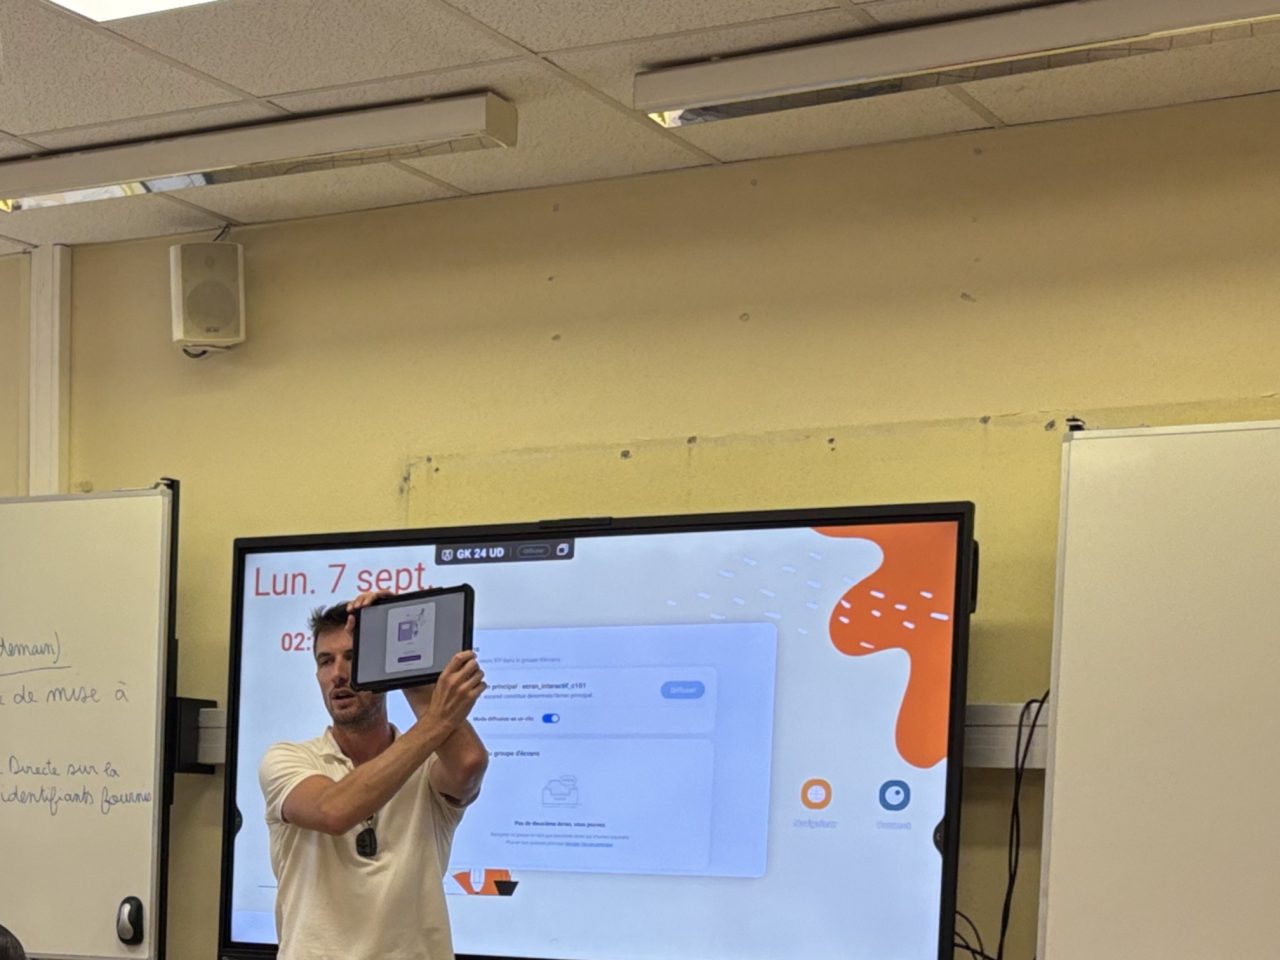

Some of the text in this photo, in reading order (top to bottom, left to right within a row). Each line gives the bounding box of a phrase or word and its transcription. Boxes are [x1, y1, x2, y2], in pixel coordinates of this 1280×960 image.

[456, 547, 505, 560] GK 24 UD
[254, 562, 433, 597] Lun. 7 sept.
[281, 632, 311, 651] 02:
[13, 685, 38, 704] de
[46, 687, 101, 704] mise
[115, 681, 129, 702] à
[9, 755, 61, 776] Directe
[67, 763, 98, 776] sur
[103, 761, 120, 778] la
[1, 785, 94, 816] identifiants
